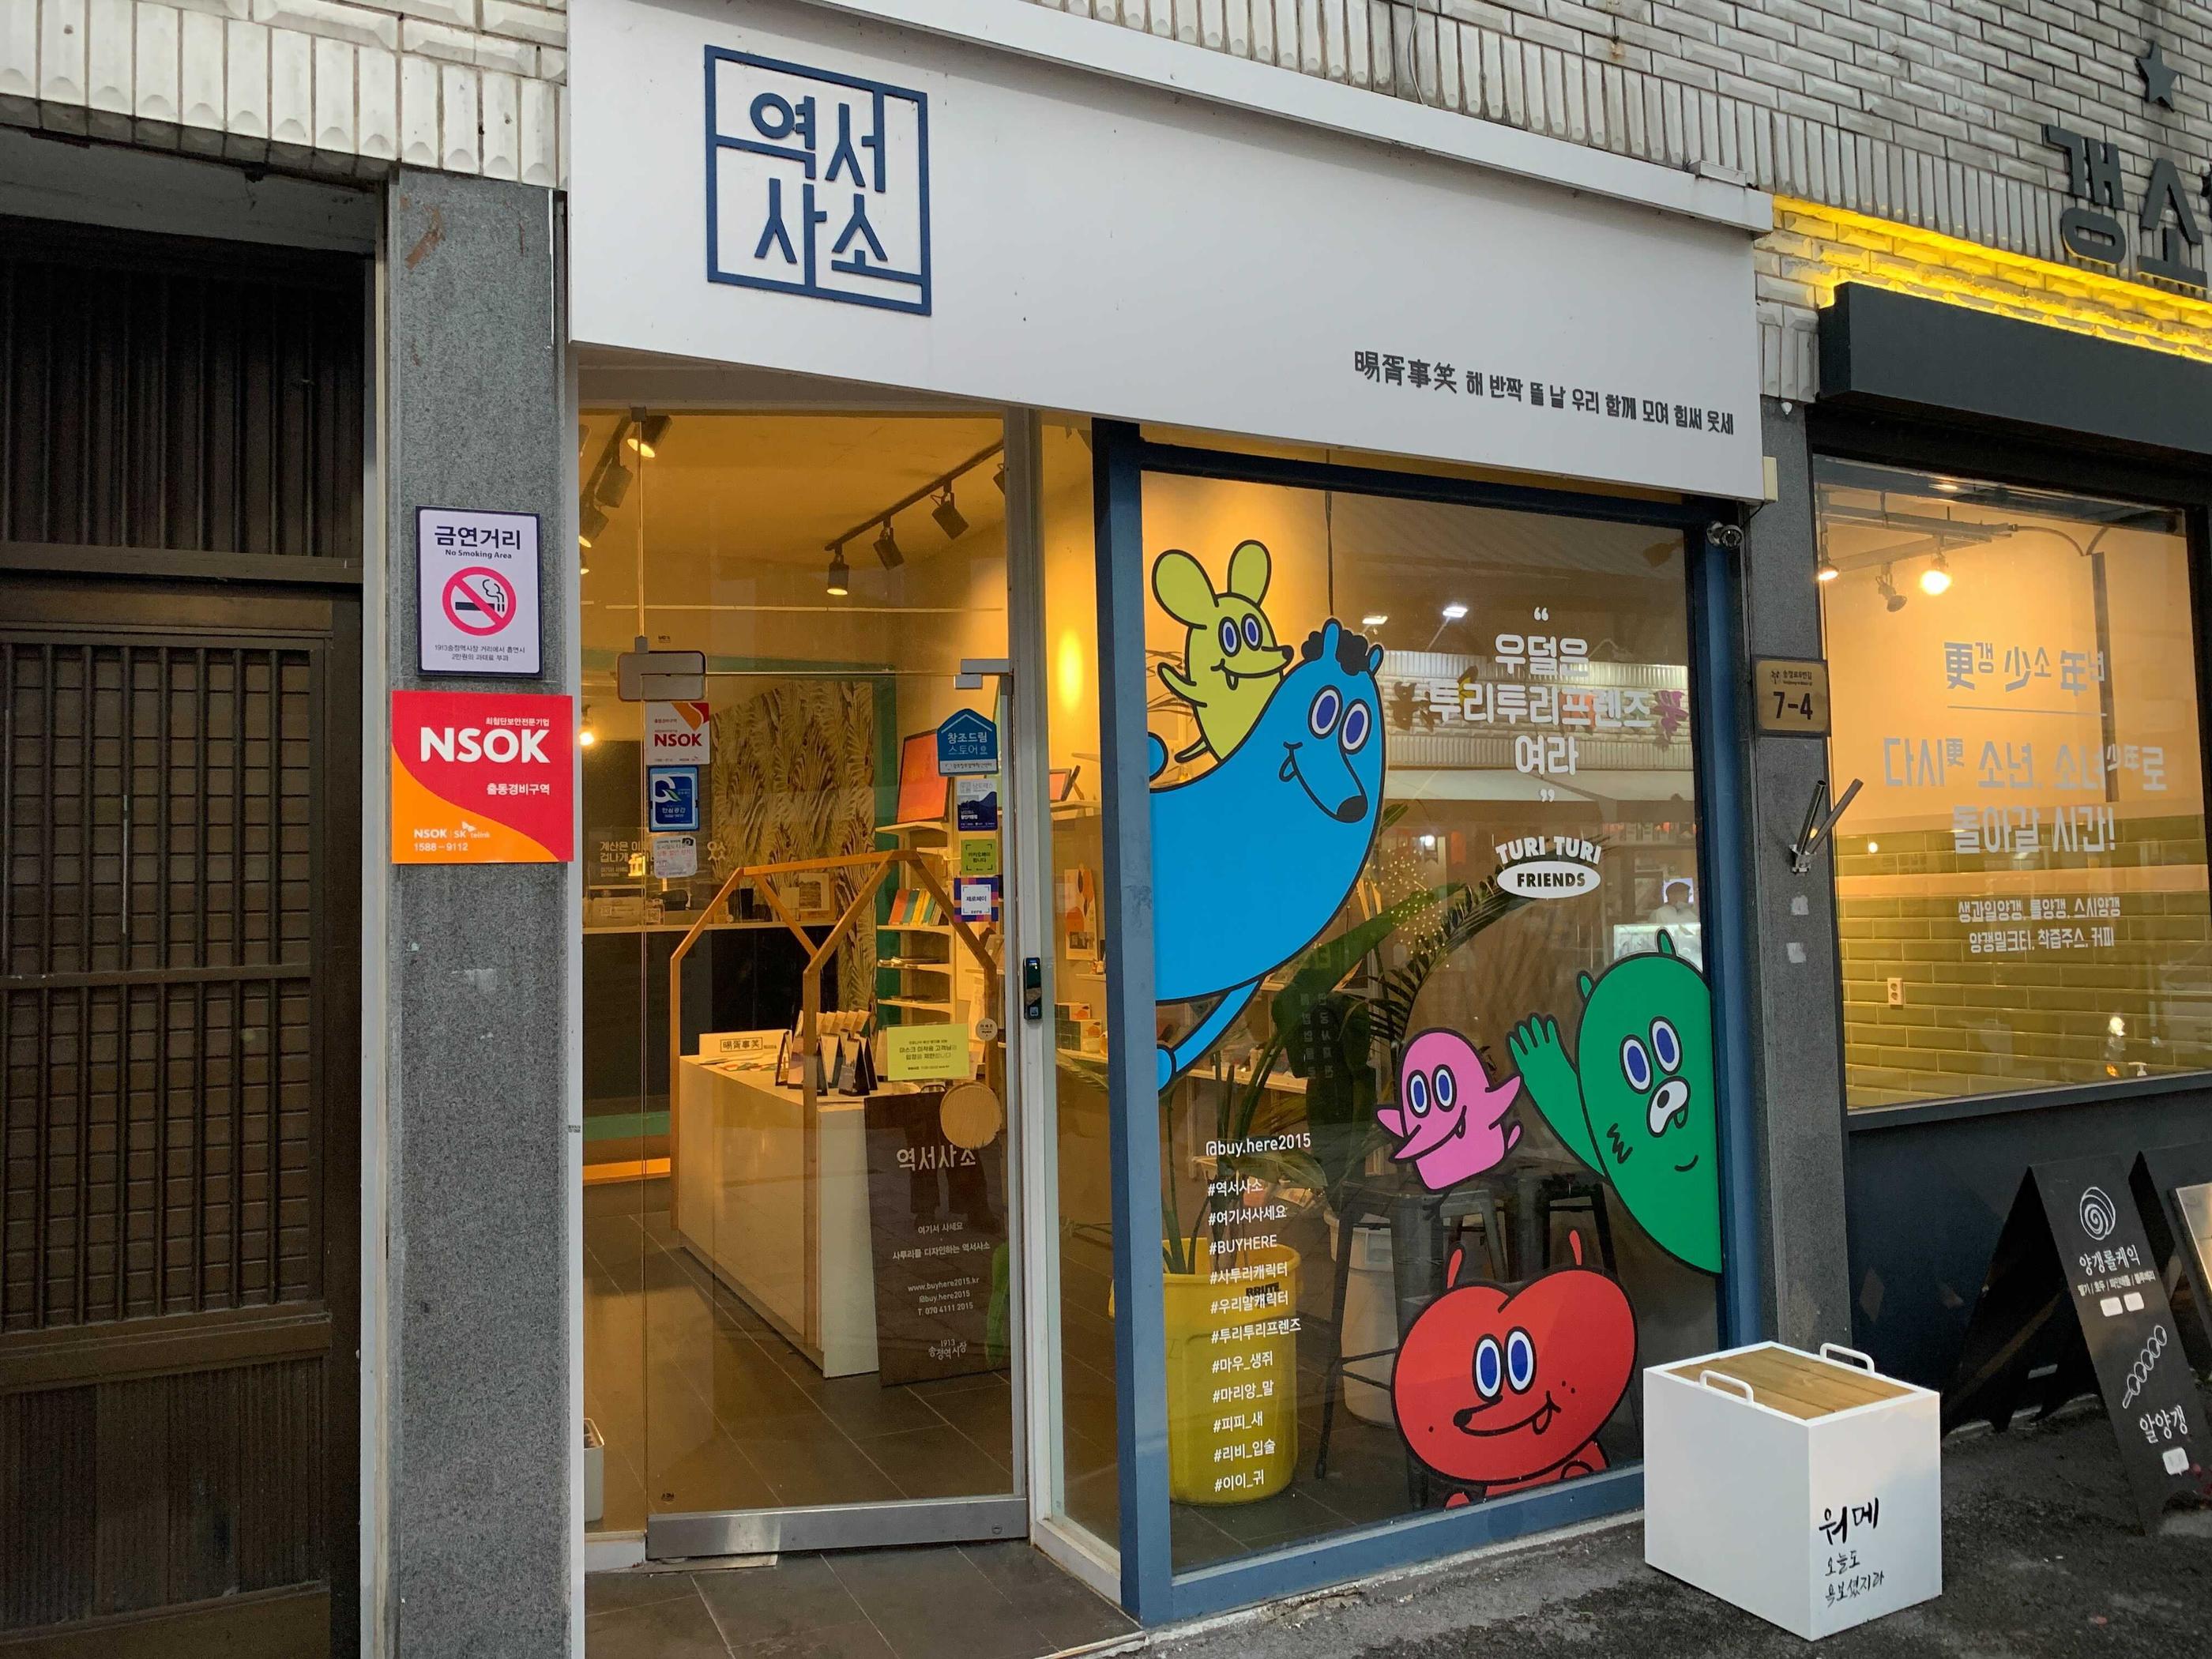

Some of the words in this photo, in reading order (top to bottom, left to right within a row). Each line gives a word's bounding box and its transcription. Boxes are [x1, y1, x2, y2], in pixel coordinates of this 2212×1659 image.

[1466, 371, 1483, 396] 해
[1490, 374, 1523, 401] 반짝
[1530, 382, 1544, 406] 뜰
[1550, 385, 1566, 408] 날
[1572, 389, 1599, 414] 우리
[1605, 394, 1636, 419] 함께
[1642, 400, 1668, 425] 모여
[1674, 404, 1702, 430] 힘써
[1707, 411, 1733, 434] 웃세
[434, 525, 521, 550] 금연거리
[458, 549, 492, 559] Smoking
[1495, 634, 1589, 676] 우덜은
[1428, 680, 1653, 728] 투리투리프렌즈
[1773, 691, 1813, 720] 7-4
[420, 727, 551, 763] NSOK
[654, 733, 702, 747] NSOK
[948, 732, 988, 744] 창조드림
[948, 744, 978, 755] 스토어
[1514, 735, 1580, 775] 여라
[487, 783, 550, 796] 출동경비구역
[413, 829, 447, 839] NSOK
[454, 830, 466, 839] SK
[1952, 805, 2040, 854] 돌아갈
[2053, 806, 2116, 852] 시간!
[600, 841, 629, 851] 계산은
[1495, 836, 1546, 865] TURI
[1554, 836, 1602, 865] TURI
[1517, 873, 1586, 887] FRIENDS
[2074, 897, 2120, 918] 스시양갱
[2091, 927, 2115, 947] 커피
[1206, 1132, 1311, 1157] @buy.here2015
[897, 1146, 976, 1171] 역서사소
[1207, 1180, 1263, 1197] #역서사소
[1208, 1205, 1287, 1226] #여기서사세요
[918, 1224, 939, 1235] 여기서
[961, 1241, 991, 1252] 역서사소
[1209, 1235, 1277, 1255] #BUYHERE
[908, 1277, 980, 1292] www.buyhere2015.kr
[1209, 1262, 1288, 1285] #사투리캐릭터
[925, 1307, 938, 1315] 070
[939, 1304, 955, 1313] 4111
[957, 1302, 973, 1311] 2015
[1210, 1290, 1288, 1315] #우리말캐릭터
[1211, 1318, 1302, 1344] #투리투리프렌즈
[1212, 1351, 1273, 1373] #마우_생쥐
[1213, 1379, 1274, 1403] #마리앙_말
[1213, 1411, 1263, 1433] #피피_새
[2139, 1405, 2188, 1444] 알양갱
[1213, 1439, 1276, 1462] #리비_입술
[1214, 1469, 1264, 1492] #이이_귀
[1819, 1497, 1879, 1545] 워메
[1825, 1550, 1860, 1576] 오늘도
